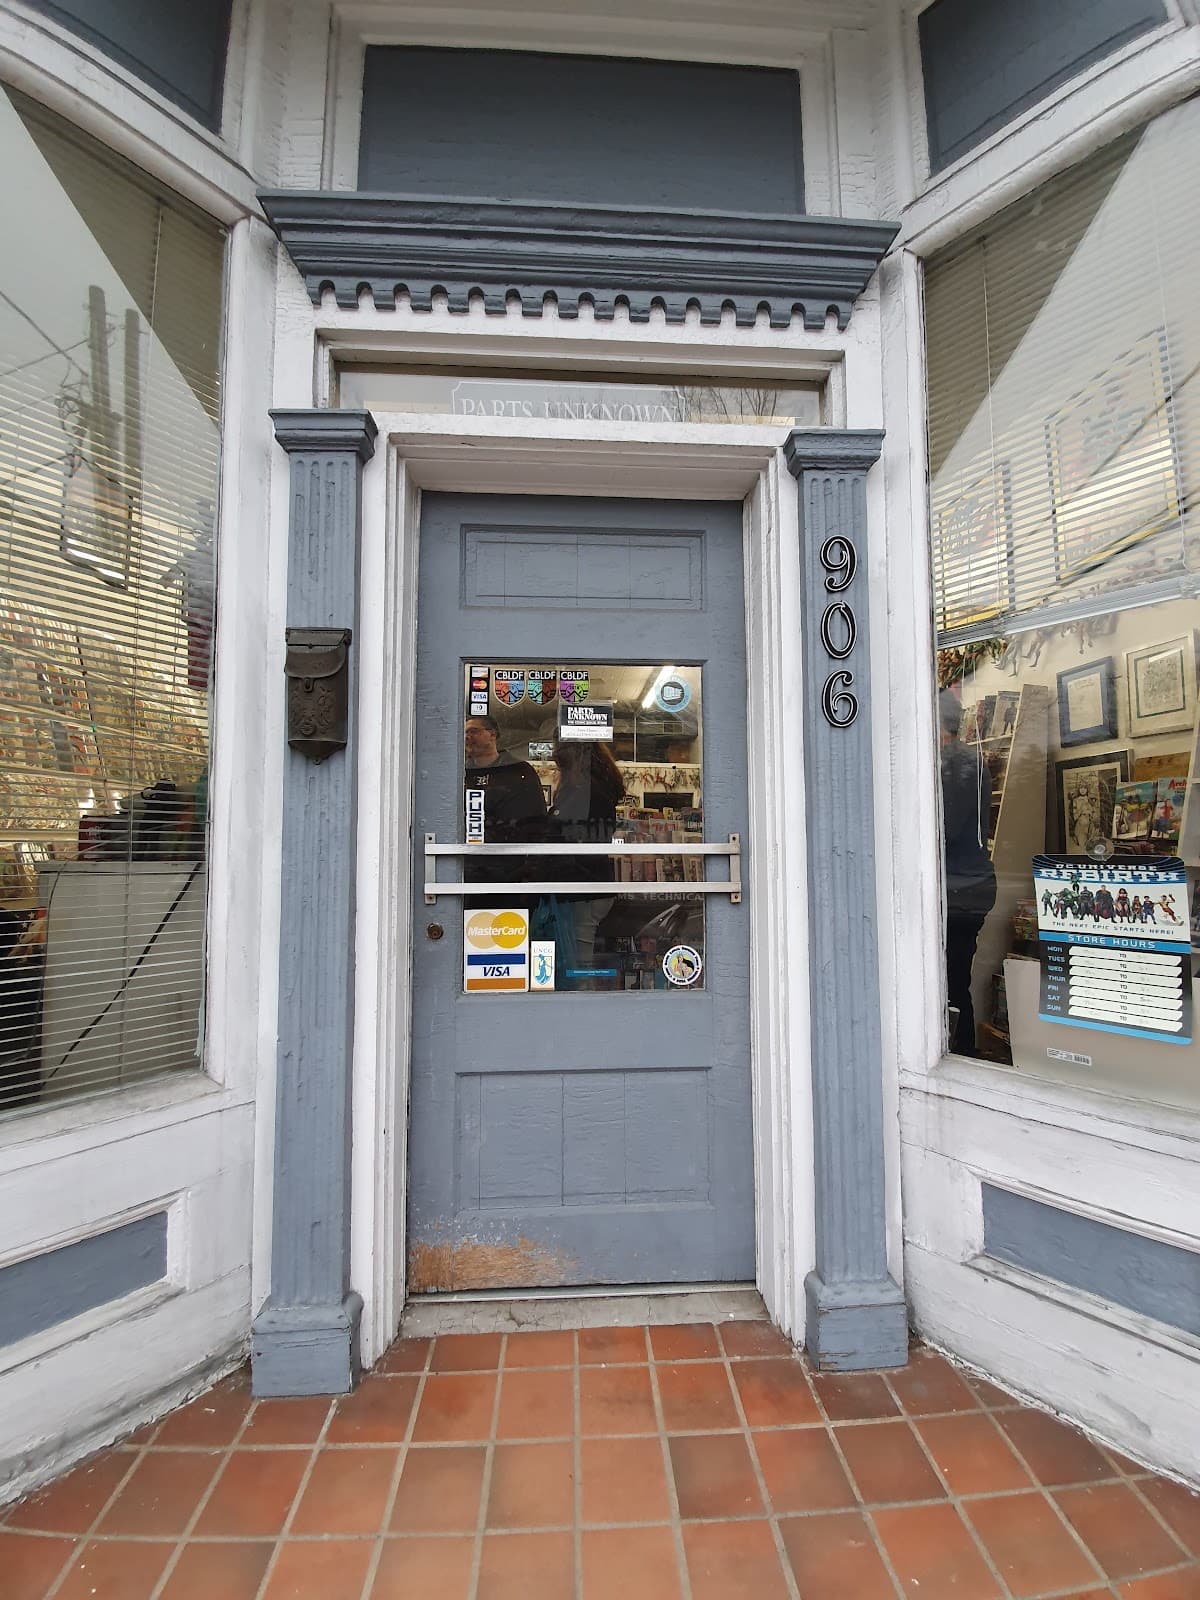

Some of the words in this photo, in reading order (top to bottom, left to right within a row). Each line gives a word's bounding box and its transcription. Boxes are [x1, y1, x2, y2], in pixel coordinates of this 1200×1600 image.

[820, 535, 859, 728] 906
[495, 671, 524, 680] CBLDF
[528, 671, 557, 680] CBLDF
[560, 671, 588, 680] CBLDF
[473, 692, 487, 700] VISA
[567, 706, 594, 714] PARTS
[567, 713, 608, 721] UNKNOWN
[469, 791, 482, 833] PUSH
[1039, 868, 1180, 883] REBIRTH
[468, 926, 526, 936] MasterCard
[1068, 935, 1105, 944] STORE
[1113, 939, 1156, 949] HOURS
[483, 966, 510, 976] VISA
